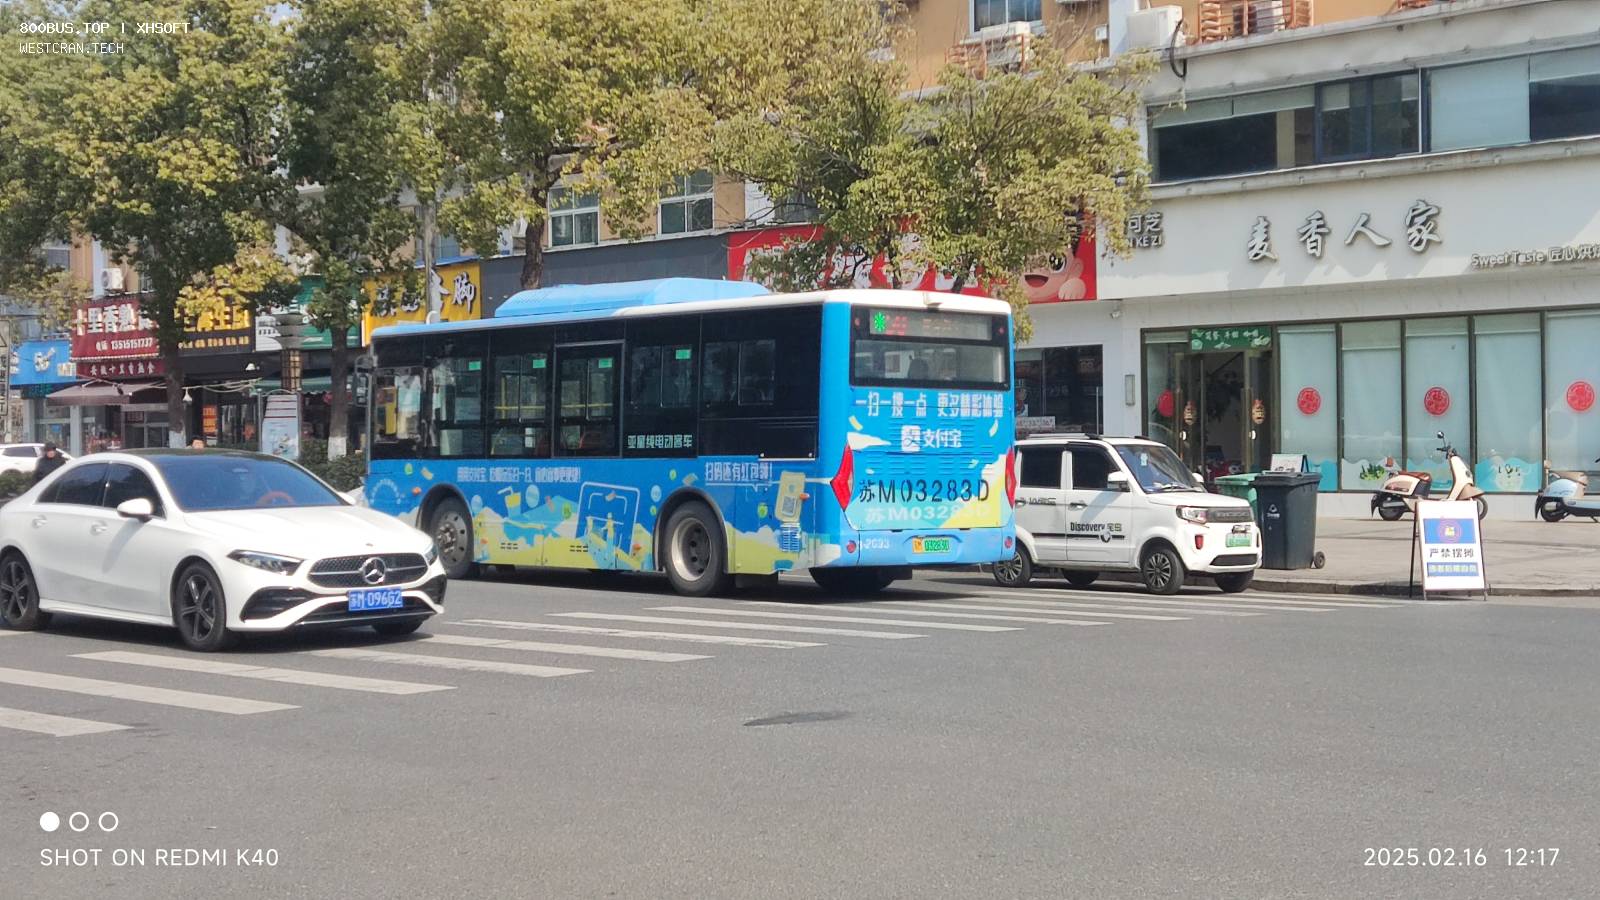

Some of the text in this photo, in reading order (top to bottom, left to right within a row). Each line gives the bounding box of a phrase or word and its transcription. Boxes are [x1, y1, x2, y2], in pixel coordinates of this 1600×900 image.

[1247, 199, 1442, 262] 麦香人家
[1471, 252, 1508, 267] Sweet
[1511, 249, 1545, 264] Taste
[923, 427, 962, 448] 支付宝
[859, 479, 990, 504] 苏M03283D
[1070, 522, 1106, 532] Discovery
